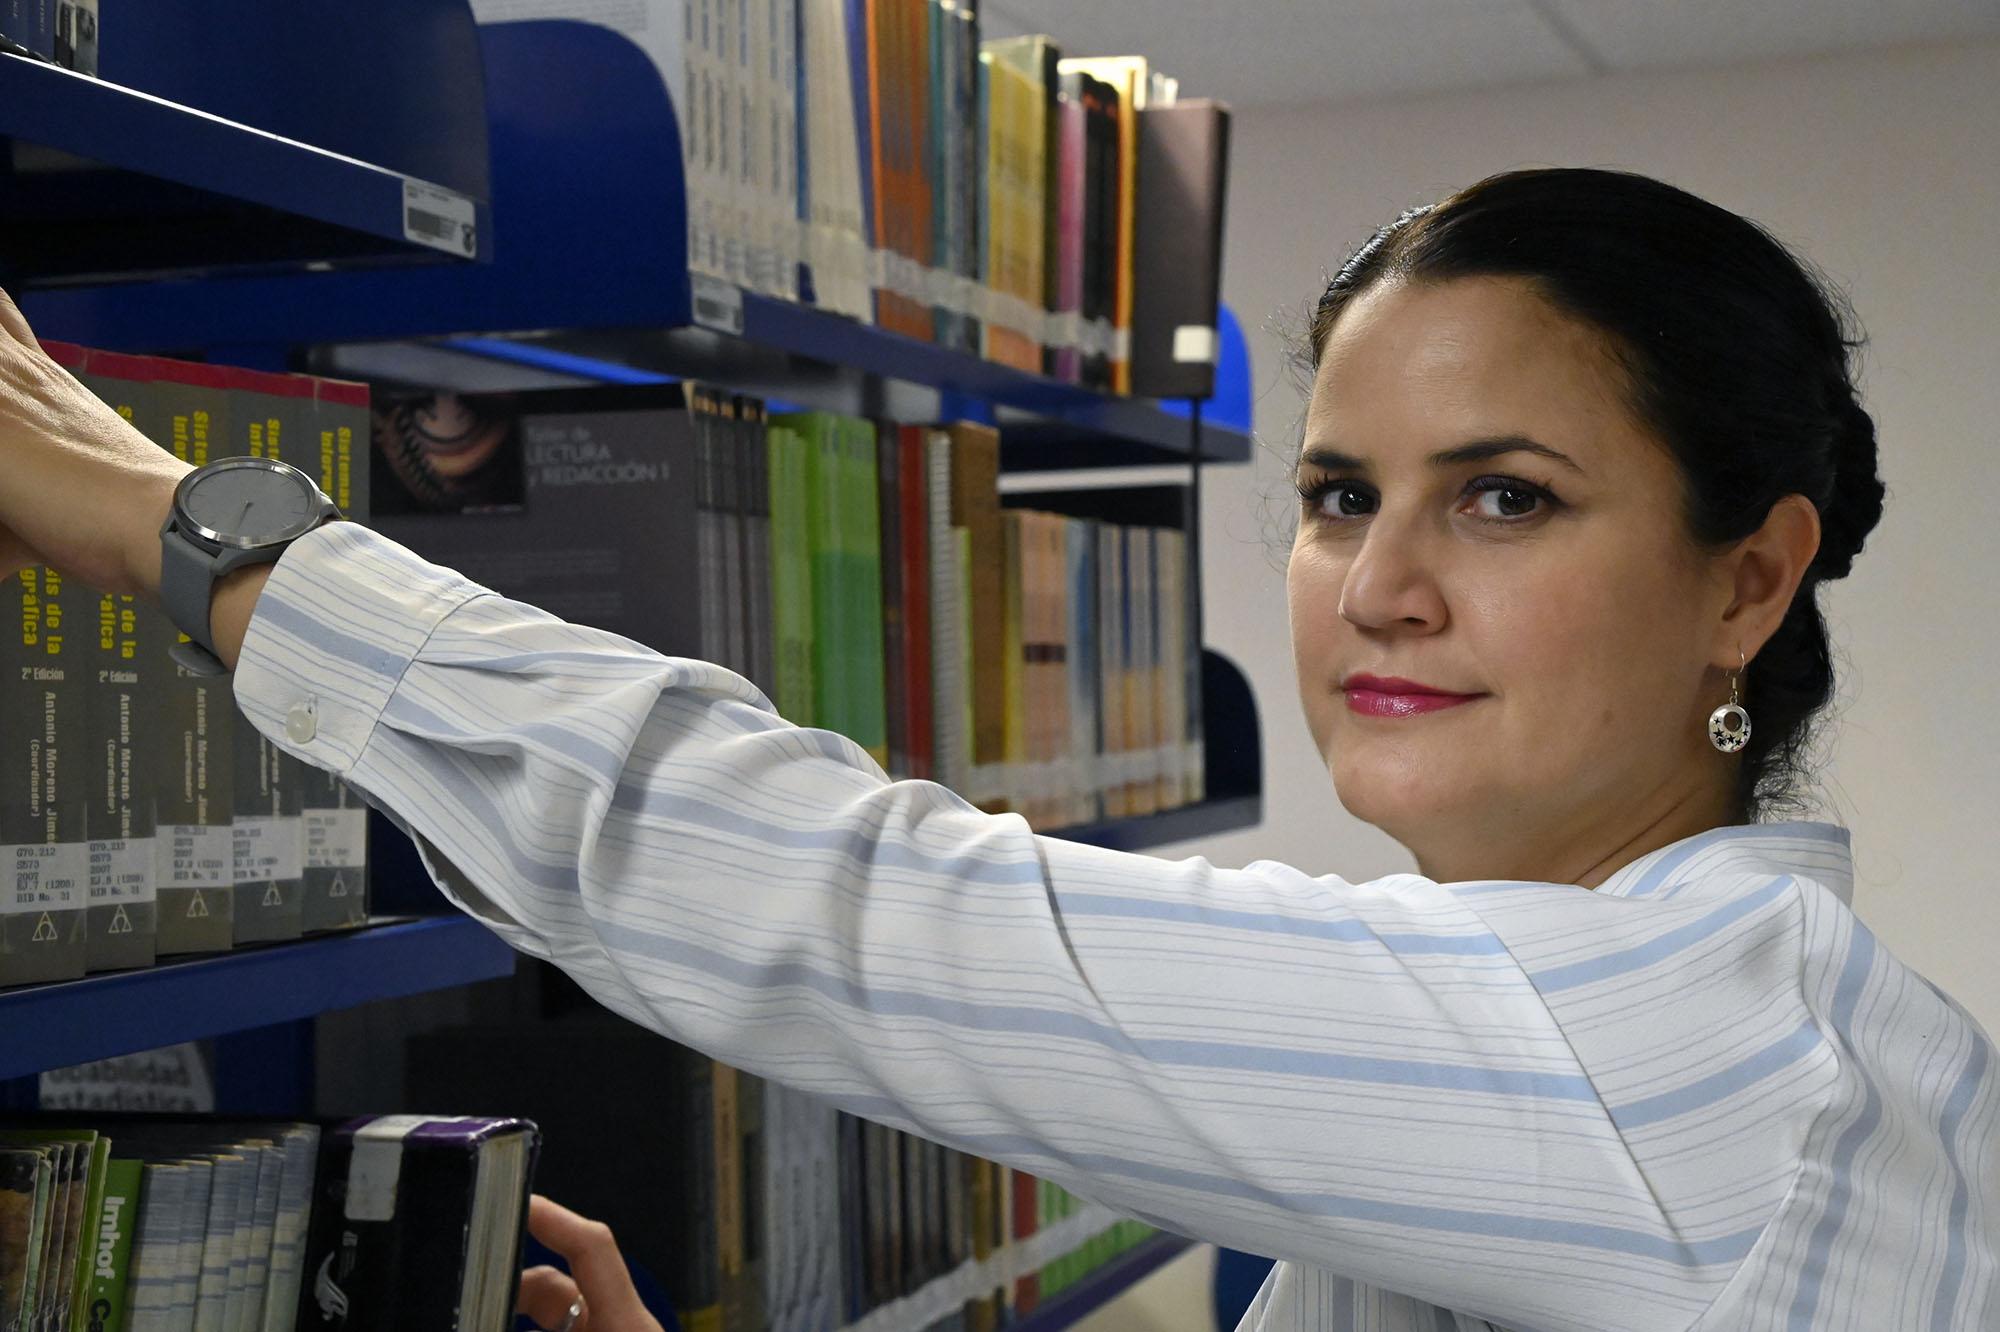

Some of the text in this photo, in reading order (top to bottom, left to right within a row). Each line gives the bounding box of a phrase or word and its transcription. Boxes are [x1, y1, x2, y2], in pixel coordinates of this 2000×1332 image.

[46, 604, 63, 629] de
[121, 609, 136, 633] de
[47, 635, 63, 654] la
[121, 640, 136, 658] la
[33, 666, 65, 680] Edición
[45, 691, 56, 743] Antonio
[120, 694, 131, 743] Antonio
[197, 687, 207, 735] Antonio
[46, 748, 57, 802] Moreno
[121, 748, 131, 800] Moreno
[197, 740, 207, 789] Moreno
[95, 1196, 126, 1280] Imhof
